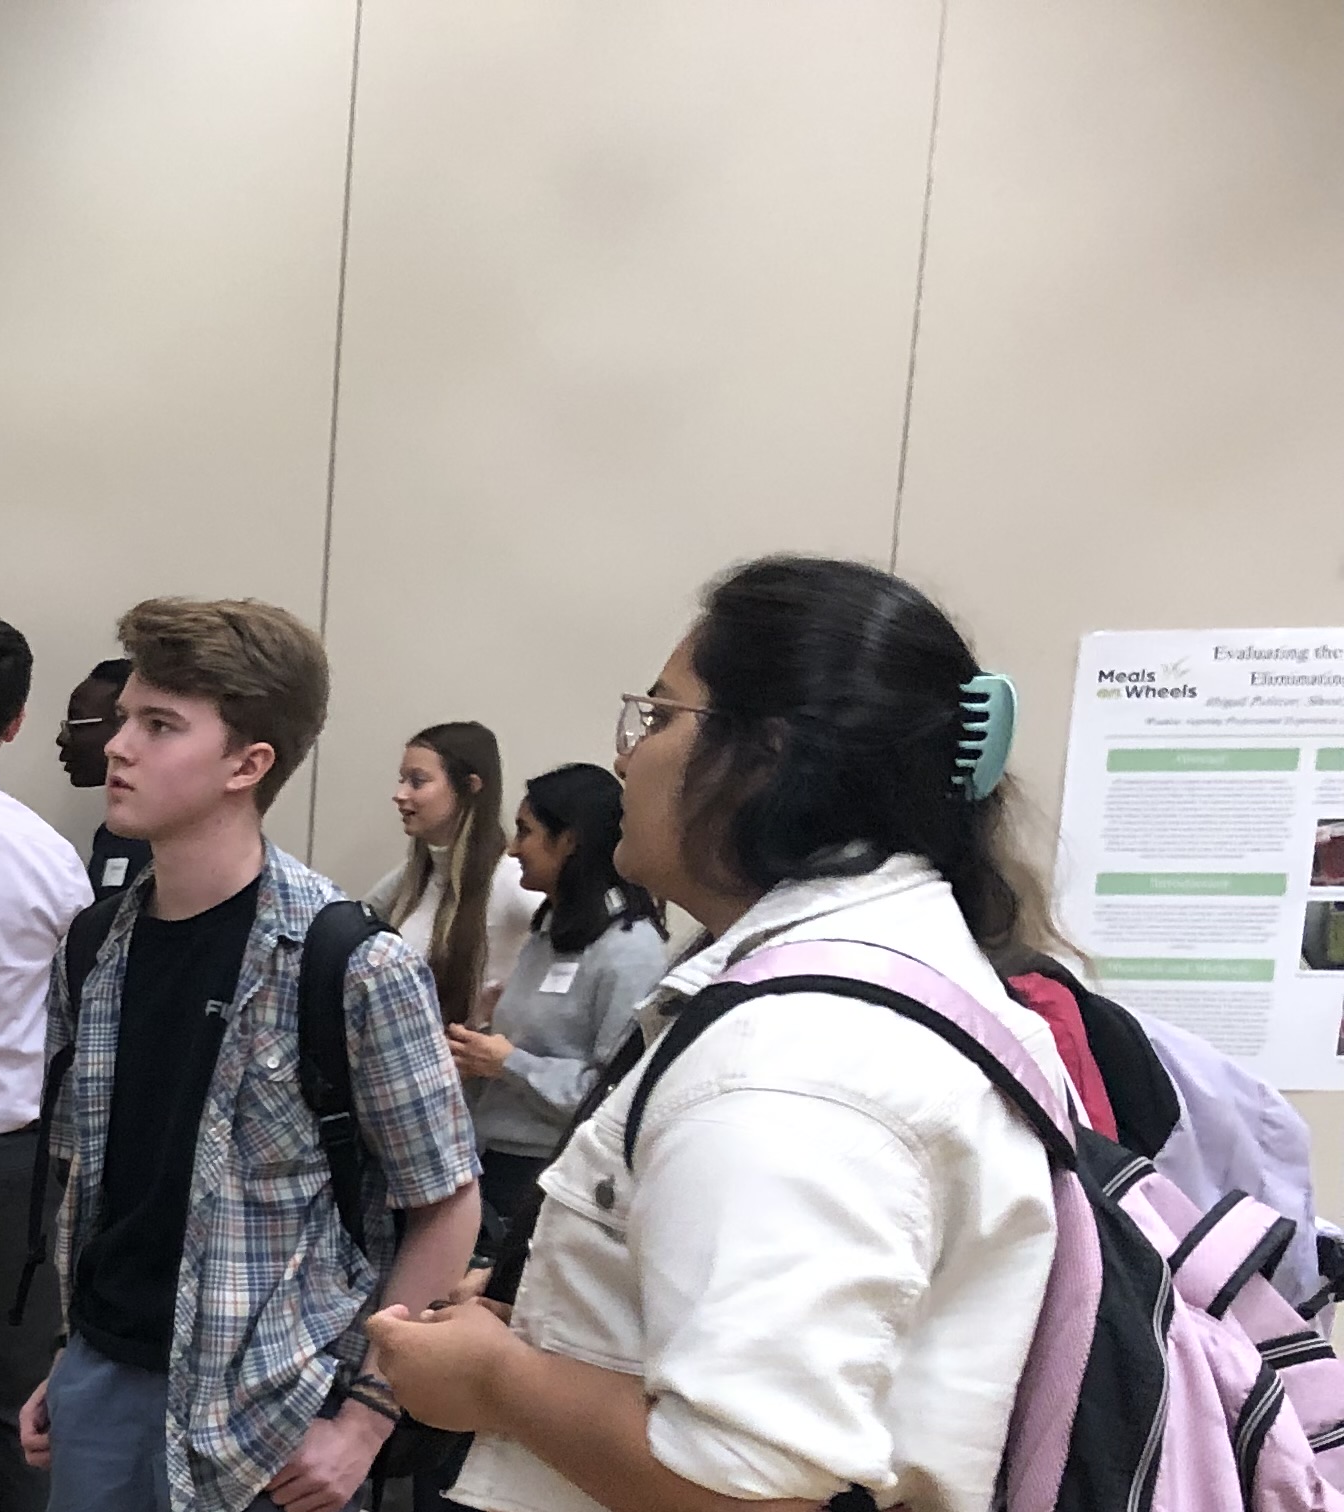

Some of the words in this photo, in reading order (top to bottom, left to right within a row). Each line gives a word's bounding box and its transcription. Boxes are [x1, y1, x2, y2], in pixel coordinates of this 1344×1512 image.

[1214, 646, 1309, 663] Evaluating
[1315, 644, 1344, 660] the
[1098, 668, 1156, 683] Meals
[1125, 684, 1198, 699] Wheels
